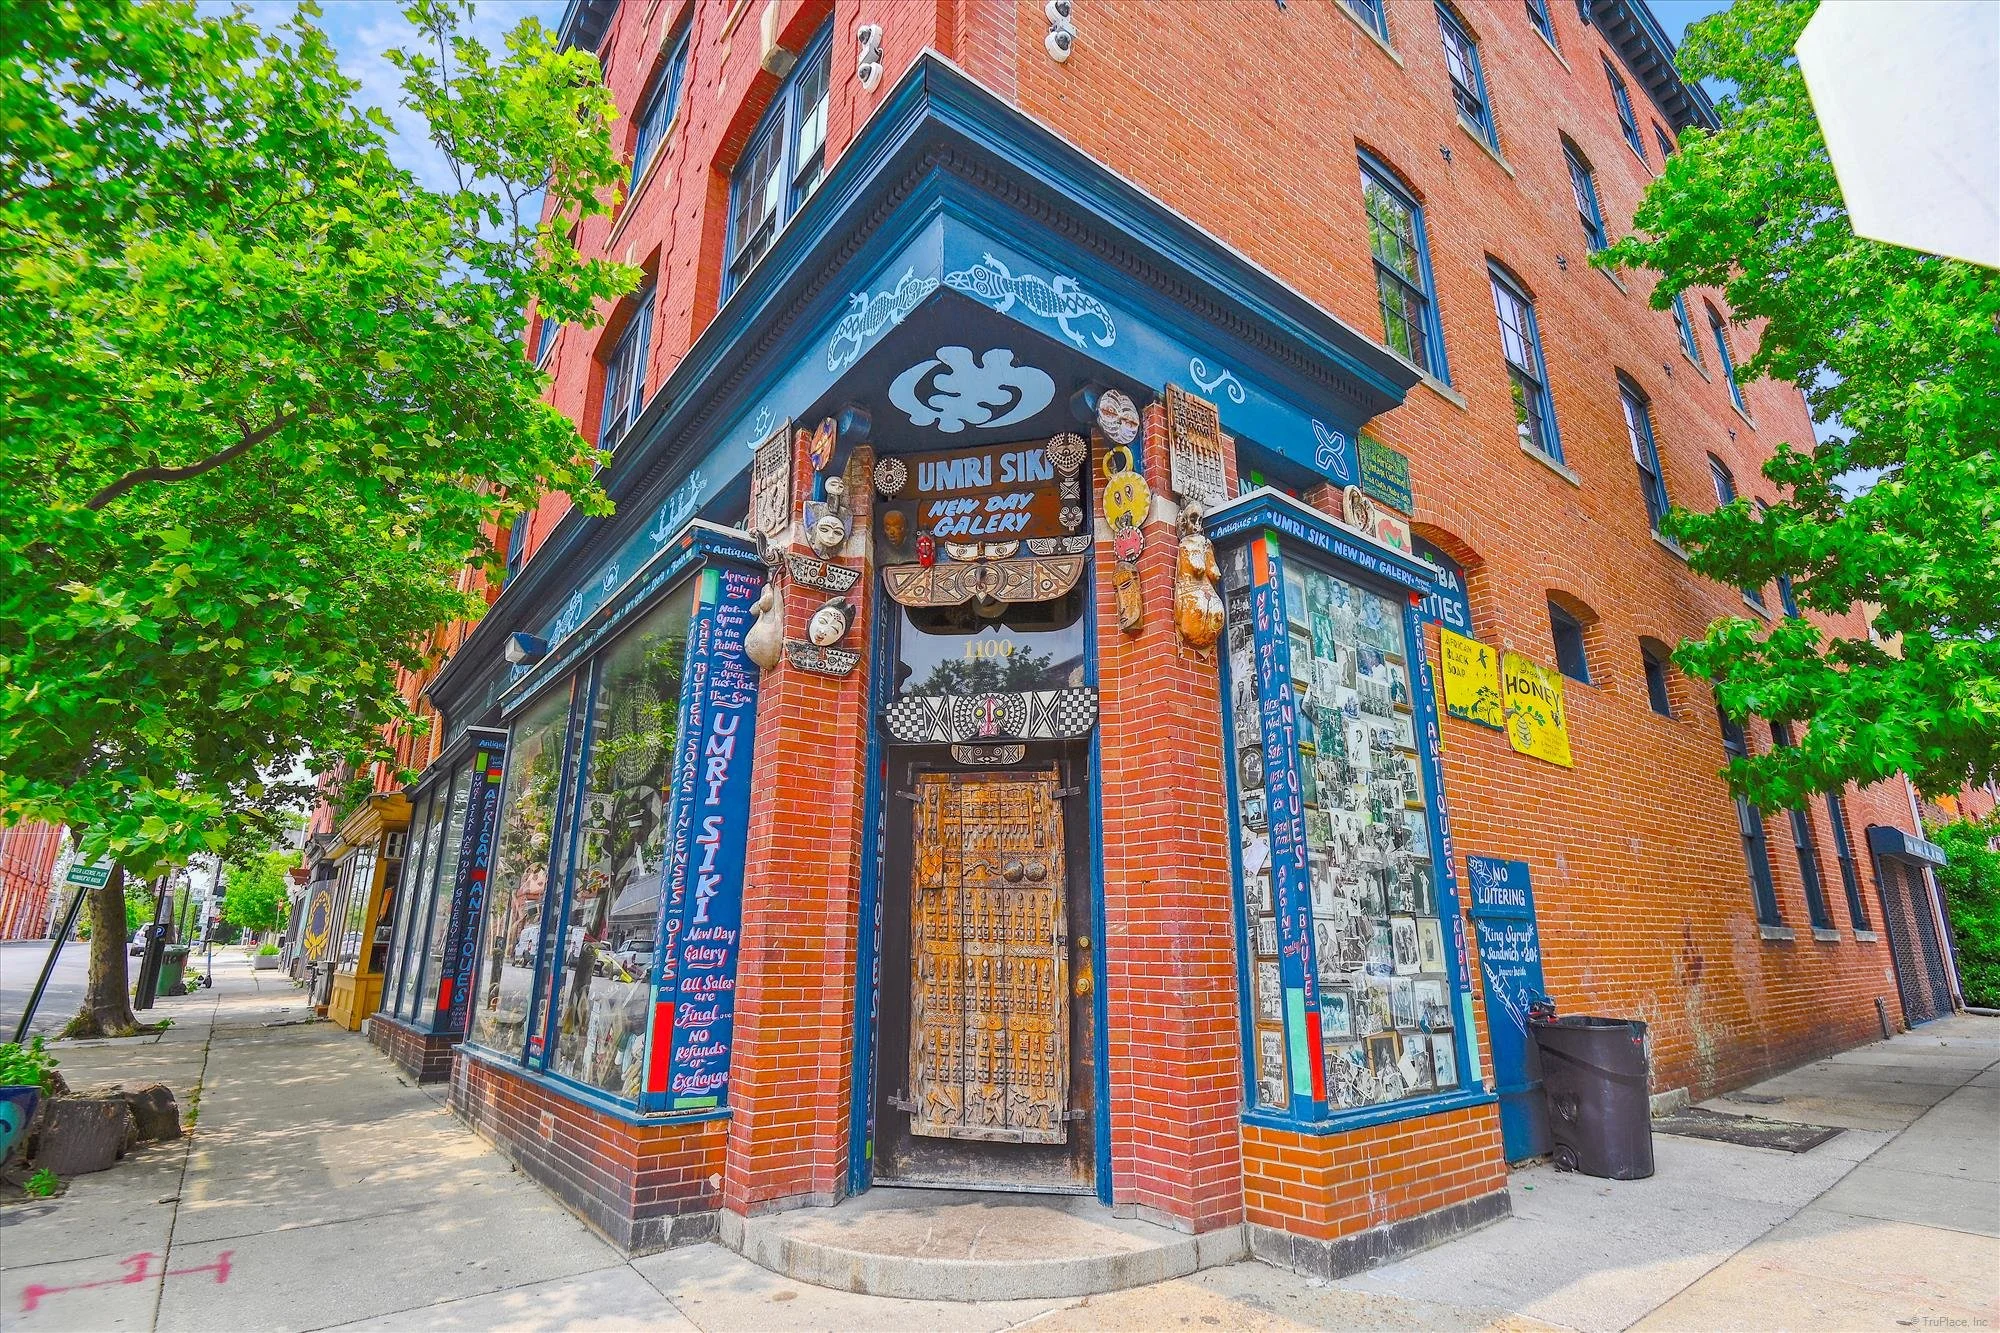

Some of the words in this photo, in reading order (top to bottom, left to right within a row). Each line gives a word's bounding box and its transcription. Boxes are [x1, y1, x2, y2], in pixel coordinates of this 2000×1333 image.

[917, 452, 993, 492] UMRI
[927, 498, 982, 519] NEW
[985, 492, 1035, 513] DAY
[933, 511, 1033, 537] GALERY
[1216, 516, 1252, 537] Antiques
[1272, 511, 1305, 538] UMRI
[1308, 528, 1330, 550] SIKI
[1334, 540, 1358, 560] NEW
[1359, 551, 1377, 570] DAY
[1380, 561, 1412, 585] GALERY
[1269, 560, 1283, 636] DOGON
[695, 618, 711, 657] SHEA
[963, 638, 1014, 660] 1100
[1412, 612, 1429, 687] SENUFO
[688, 661, 708, 727] BUTTER
[1505, 673, 1560, 715] HONEY
[681, 738, 700, 793] SOAPS
[704, 712, 740, 806] UMRI
[1279, 683, 1306, 870] ANTIQUES
[475, 788, 496, 868] AFRICAN
[1426, 720, 1455, 880] ANTIQUES
[691, 814, 723, 925] SIKI
[1478, 886, 1526, 907] LOITERING
[1493, 865, 1508, 882] NO
[454, 881, 485, 1004] ANTIQUES
[1299, 913, 1315, 998] BAULE
[1453, 920, 1469, 985] KUBA
[1484, 926, 1504, 947] King
[1505, 925, 1532, 949] Syrup
[1487, 946, 1519, 962] Sandwich
